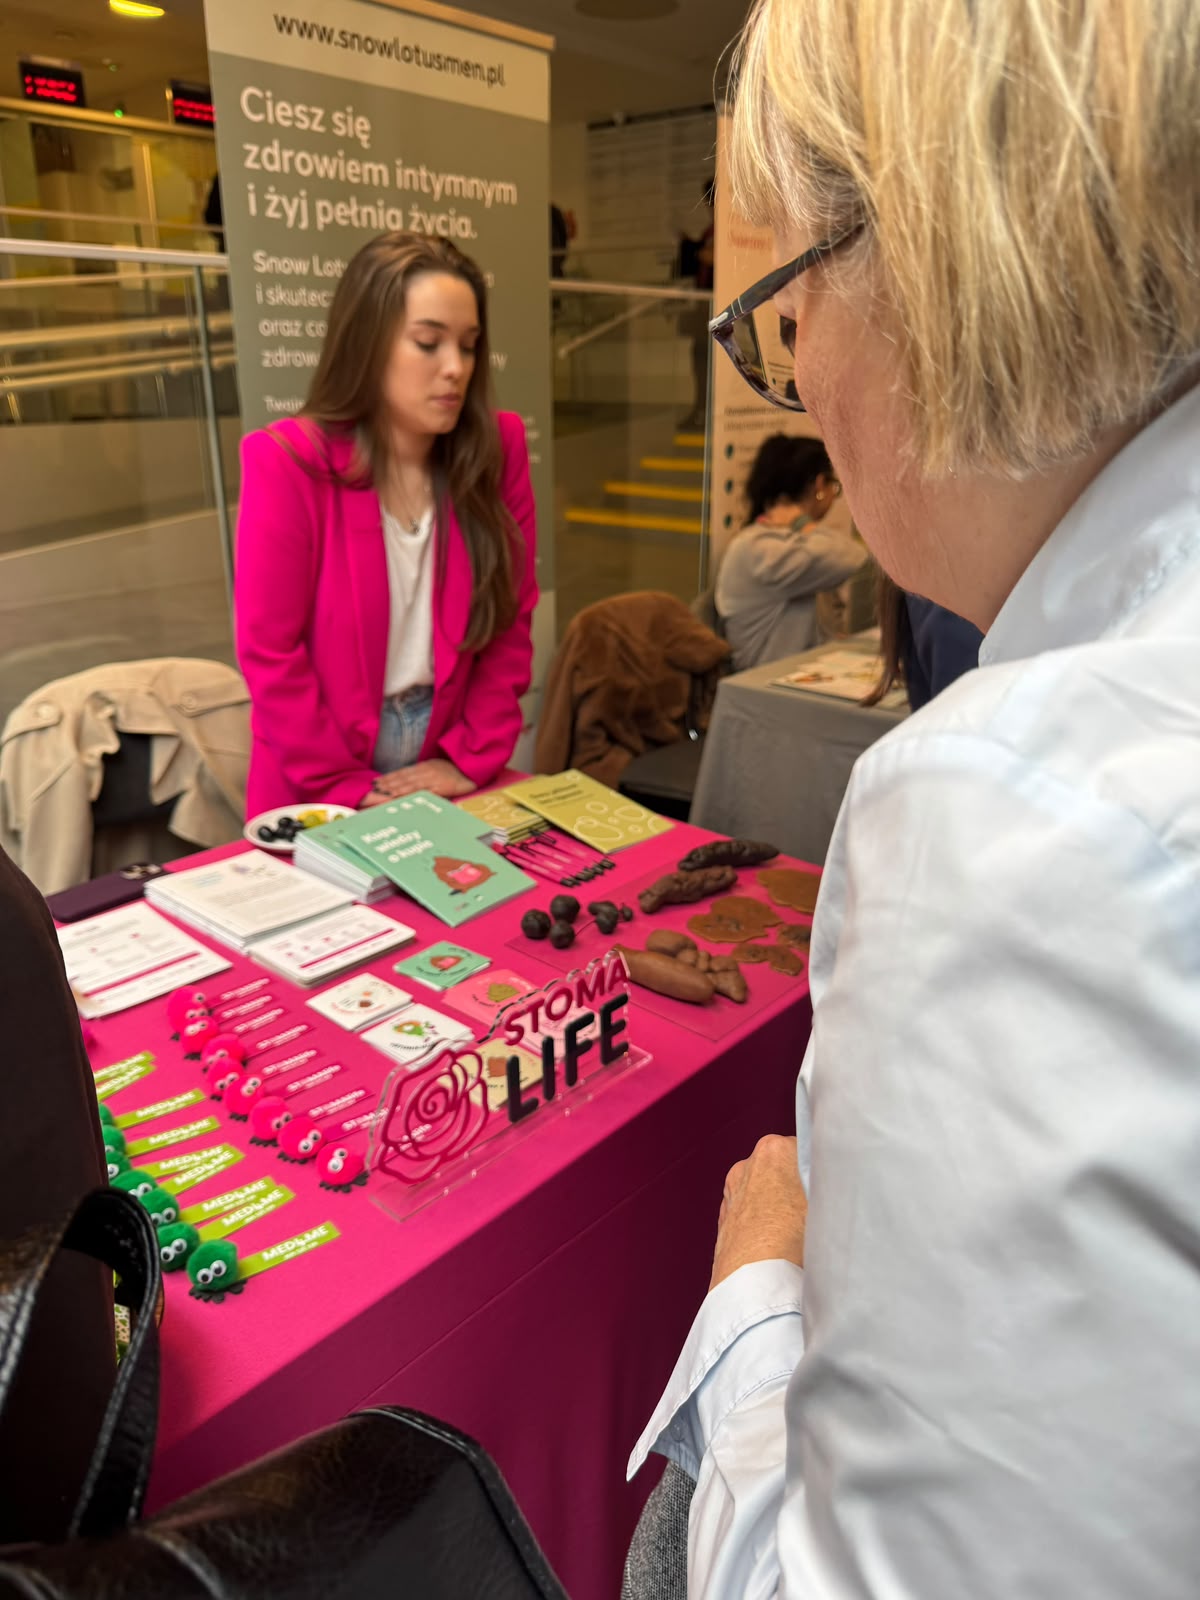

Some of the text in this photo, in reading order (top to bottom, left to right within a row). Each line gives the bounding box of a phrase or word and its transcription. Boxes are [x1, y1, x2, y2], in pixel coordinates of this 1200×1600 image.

[274, 13, 506, 88] www.snowlotusmen.pl
[240, 86, 326, 133] Ciesz
[331, 105, 371, 149] się
[243, 139, 518, 208] zdrowiem intymnym
[247, 183, 257, 216] i
[264, 186, 309, 230] żyj
[408, 203, 478, 239] życia.
[253, 250, 310, 275] Snow
[255, 282, 263, 304] i
[259, 319, 303, 337] oraz
[504, 958, 630, 1046] STOMA
[505, 992, 630, 1124] LIFE
[174, 1150, 234, 1186] MED4ME
[202, 1179, 268, 1213] MED4ME
[221, 1188, 284, 1227] MED4ME
[261, 1225, 329, 1262] MED4ME
